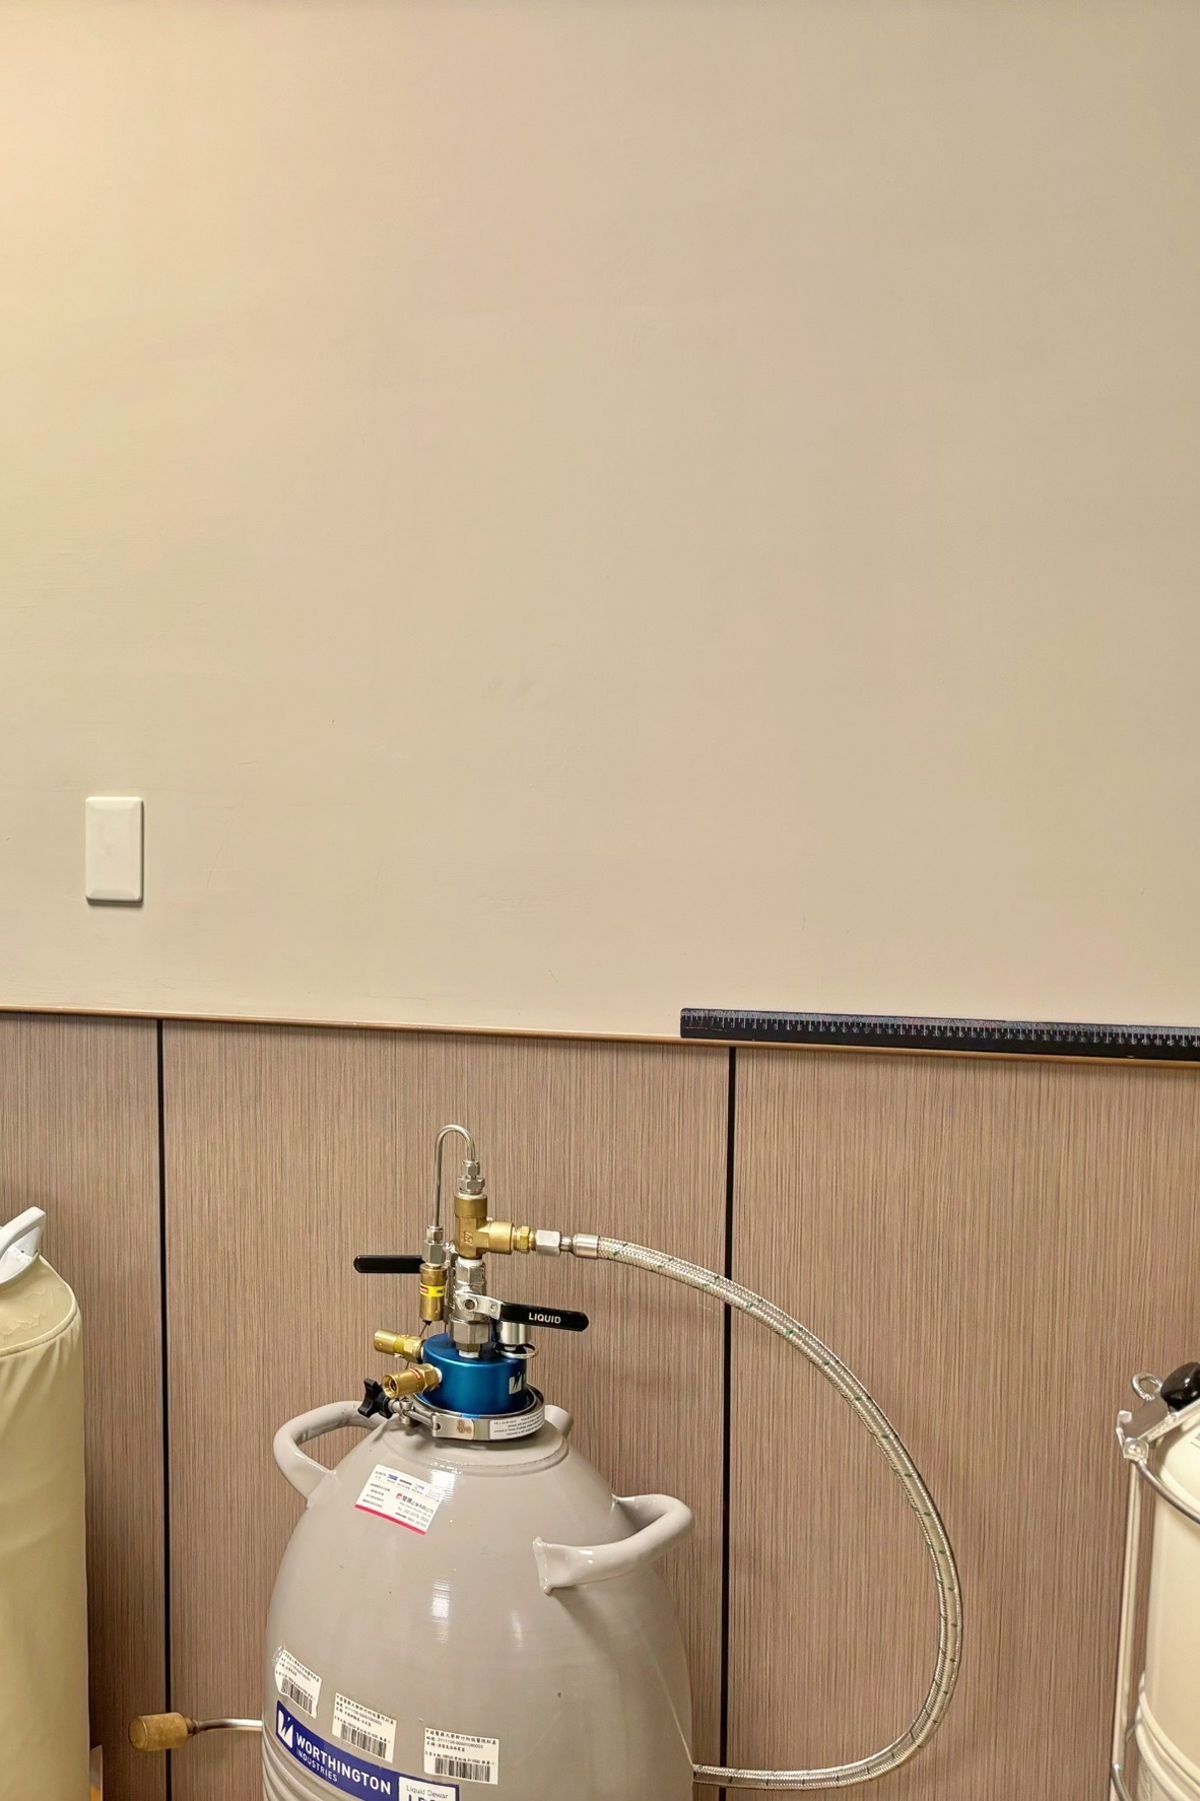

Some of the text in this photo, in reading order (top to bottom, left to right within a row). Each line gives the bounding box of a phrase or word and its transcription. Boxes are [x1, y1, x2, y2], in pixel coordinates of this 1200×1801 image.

[528, 1312, 562, 1324] LIQUID
[295, 1731, 392, 1795] WORTHINGTON
[296, 1747, 338, 1782] INDUSTRIES
[406, 1785, 426, 1796] Liquid
[427, 1789, 449, 1799] Dewar
